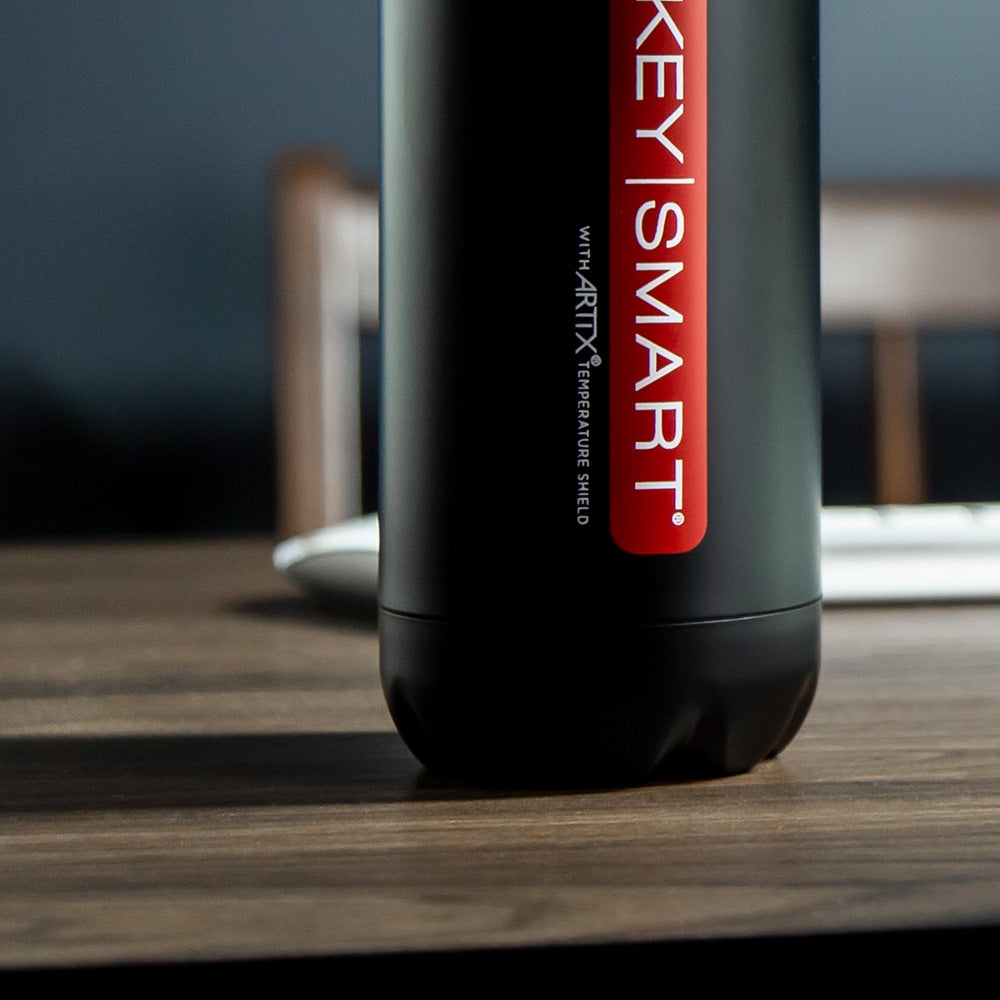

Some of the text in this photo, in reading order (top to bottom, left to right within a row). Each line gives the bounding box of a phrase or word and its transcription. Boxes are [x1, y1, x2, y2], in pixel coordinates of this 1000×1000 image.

[578, 225, 591, 271] WITH
[577, 360, 591, 468] TEMPERATURE
[576, 473, 590, 525] SHIELD
